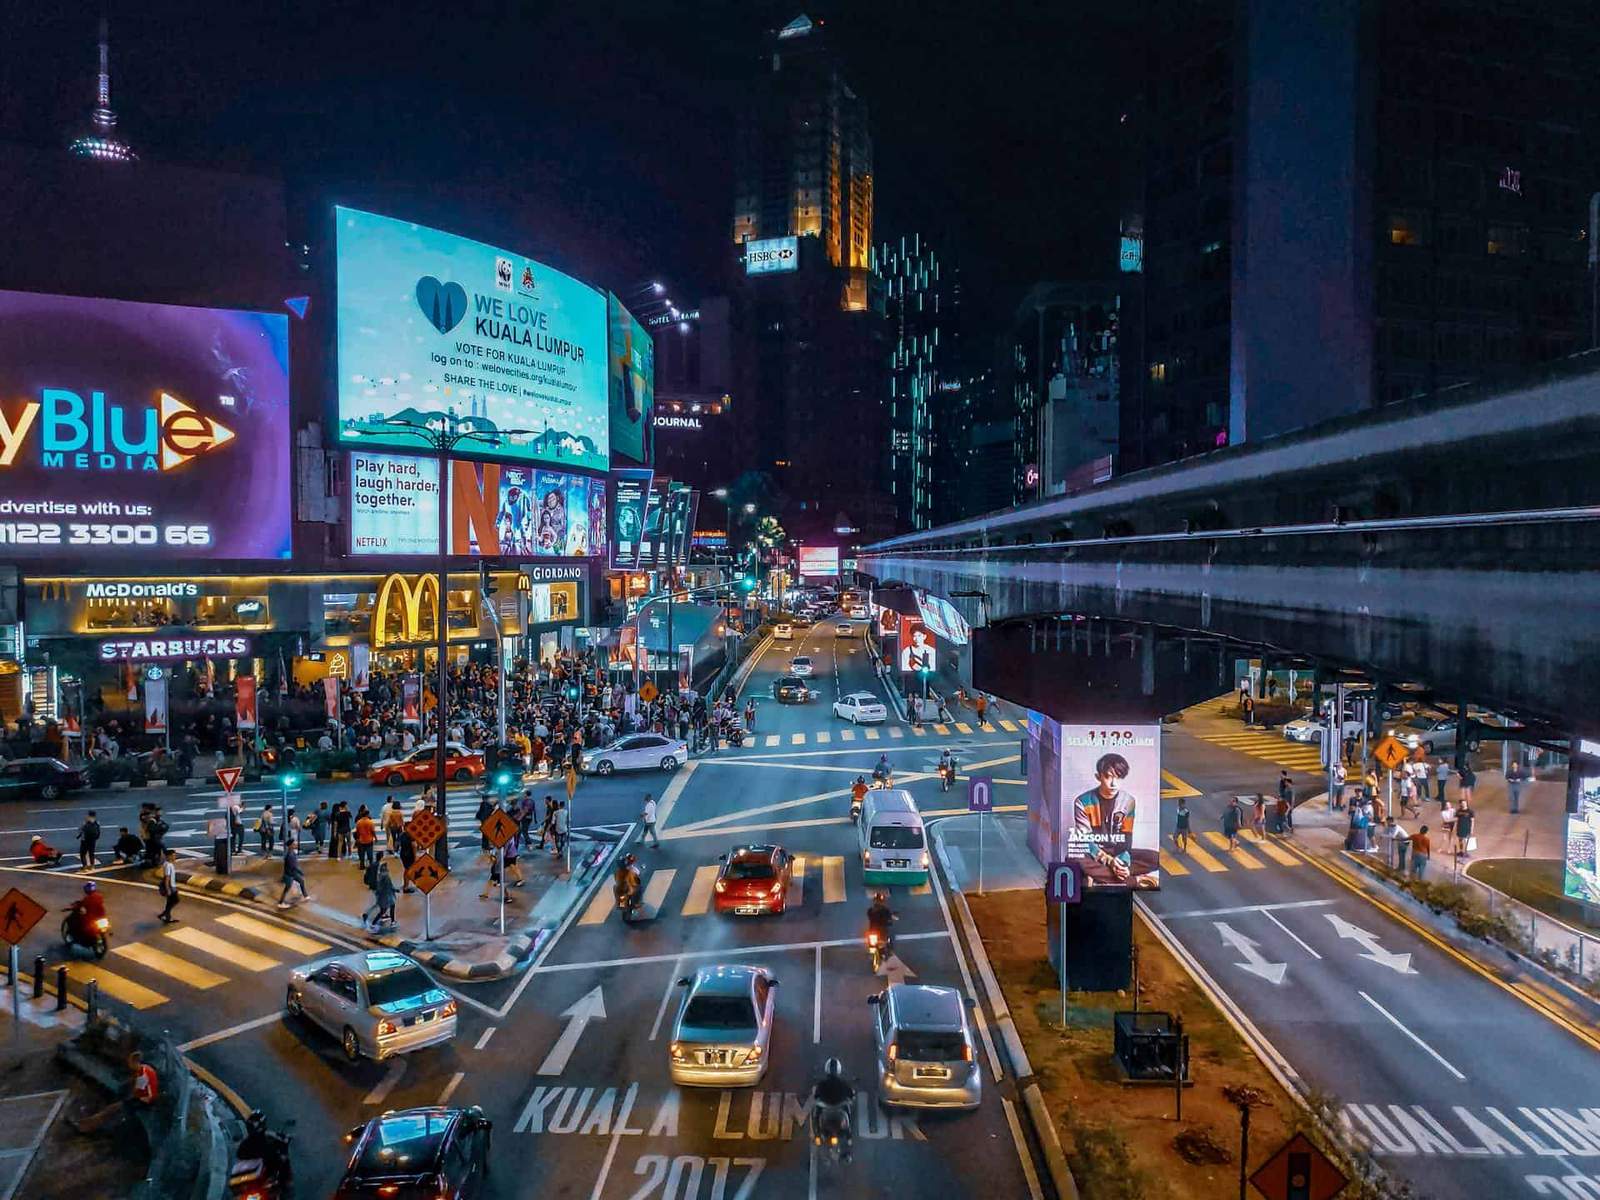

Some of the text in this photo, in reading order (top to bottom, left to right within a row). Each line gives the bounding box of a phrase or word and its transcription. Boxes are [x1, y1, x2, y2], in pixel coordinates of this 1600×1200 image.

[749, 250, 777, 262] HSBC
[474, 294, 547, 331] WE LOVE
[476, 316, 584, 362] KUALA LUMPUR
[431, 352, 447, 366] log
[449, 356, 462, 366] on
[456, 342, 566, 376] VOTE FOR KUALA LUMPUR
[444, 373, 476, 387] SHARE
[479, 378, 495, 390] THE
[497, 383, 518, 394] LOVE
[653, 416, 702, 428] JOURNAL
[43, 453, 159, 471] MEDIA
[355, 459, 420, 478] Play hard,
[355, 475, 439, 495] laugh harder,
[0, 500, 152, 515] dvertise with us:
[355, 492, 415, 508] together.
[69, 524, 158, 544] 3300
[165, 525, 210, 544] 66
[356, 537, 387, 547] NETFLIX
[533, 566, 581, 580] GIORDANO
[87, 583, 198, 597] McDonald's
[102, 638, 246, 658] STARBUCKS
[1067, 833, 1126, 843] JACKSON YEE
[513, 1083, 682, 1136] KUALA
[1342, 1103, 1525, 1156] UALA
[628, 1154, 767, 1200] 2017
